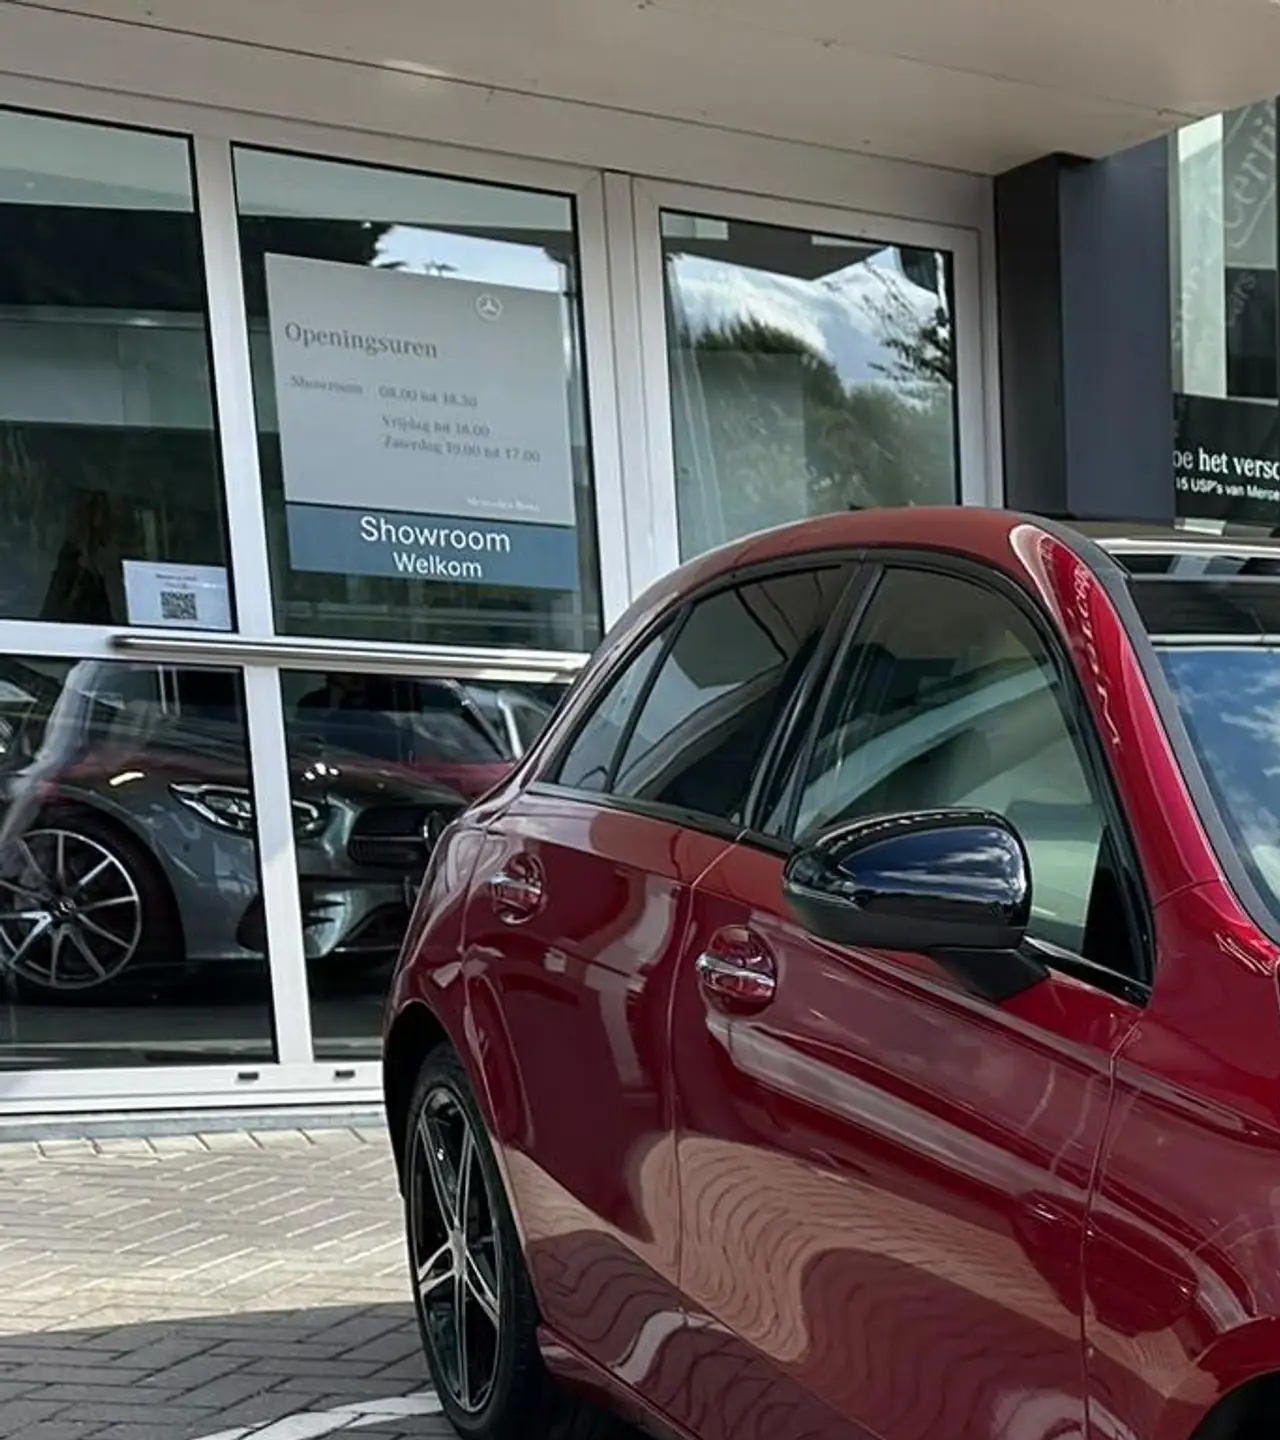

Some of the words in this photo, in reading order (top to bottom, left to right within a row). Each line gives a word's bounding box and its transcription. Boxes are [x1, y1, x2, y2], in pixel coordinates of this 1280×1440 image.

[285, 321, 437, 358] Openingsuren
[1173, 449, 1194, 470] oe
[1198, 446, 1229, 474] het
[1246, 484, 1280, 502] Merce
[360, 515, 511, 553] Showroom
[393, 551, 482, 578] Welkom
